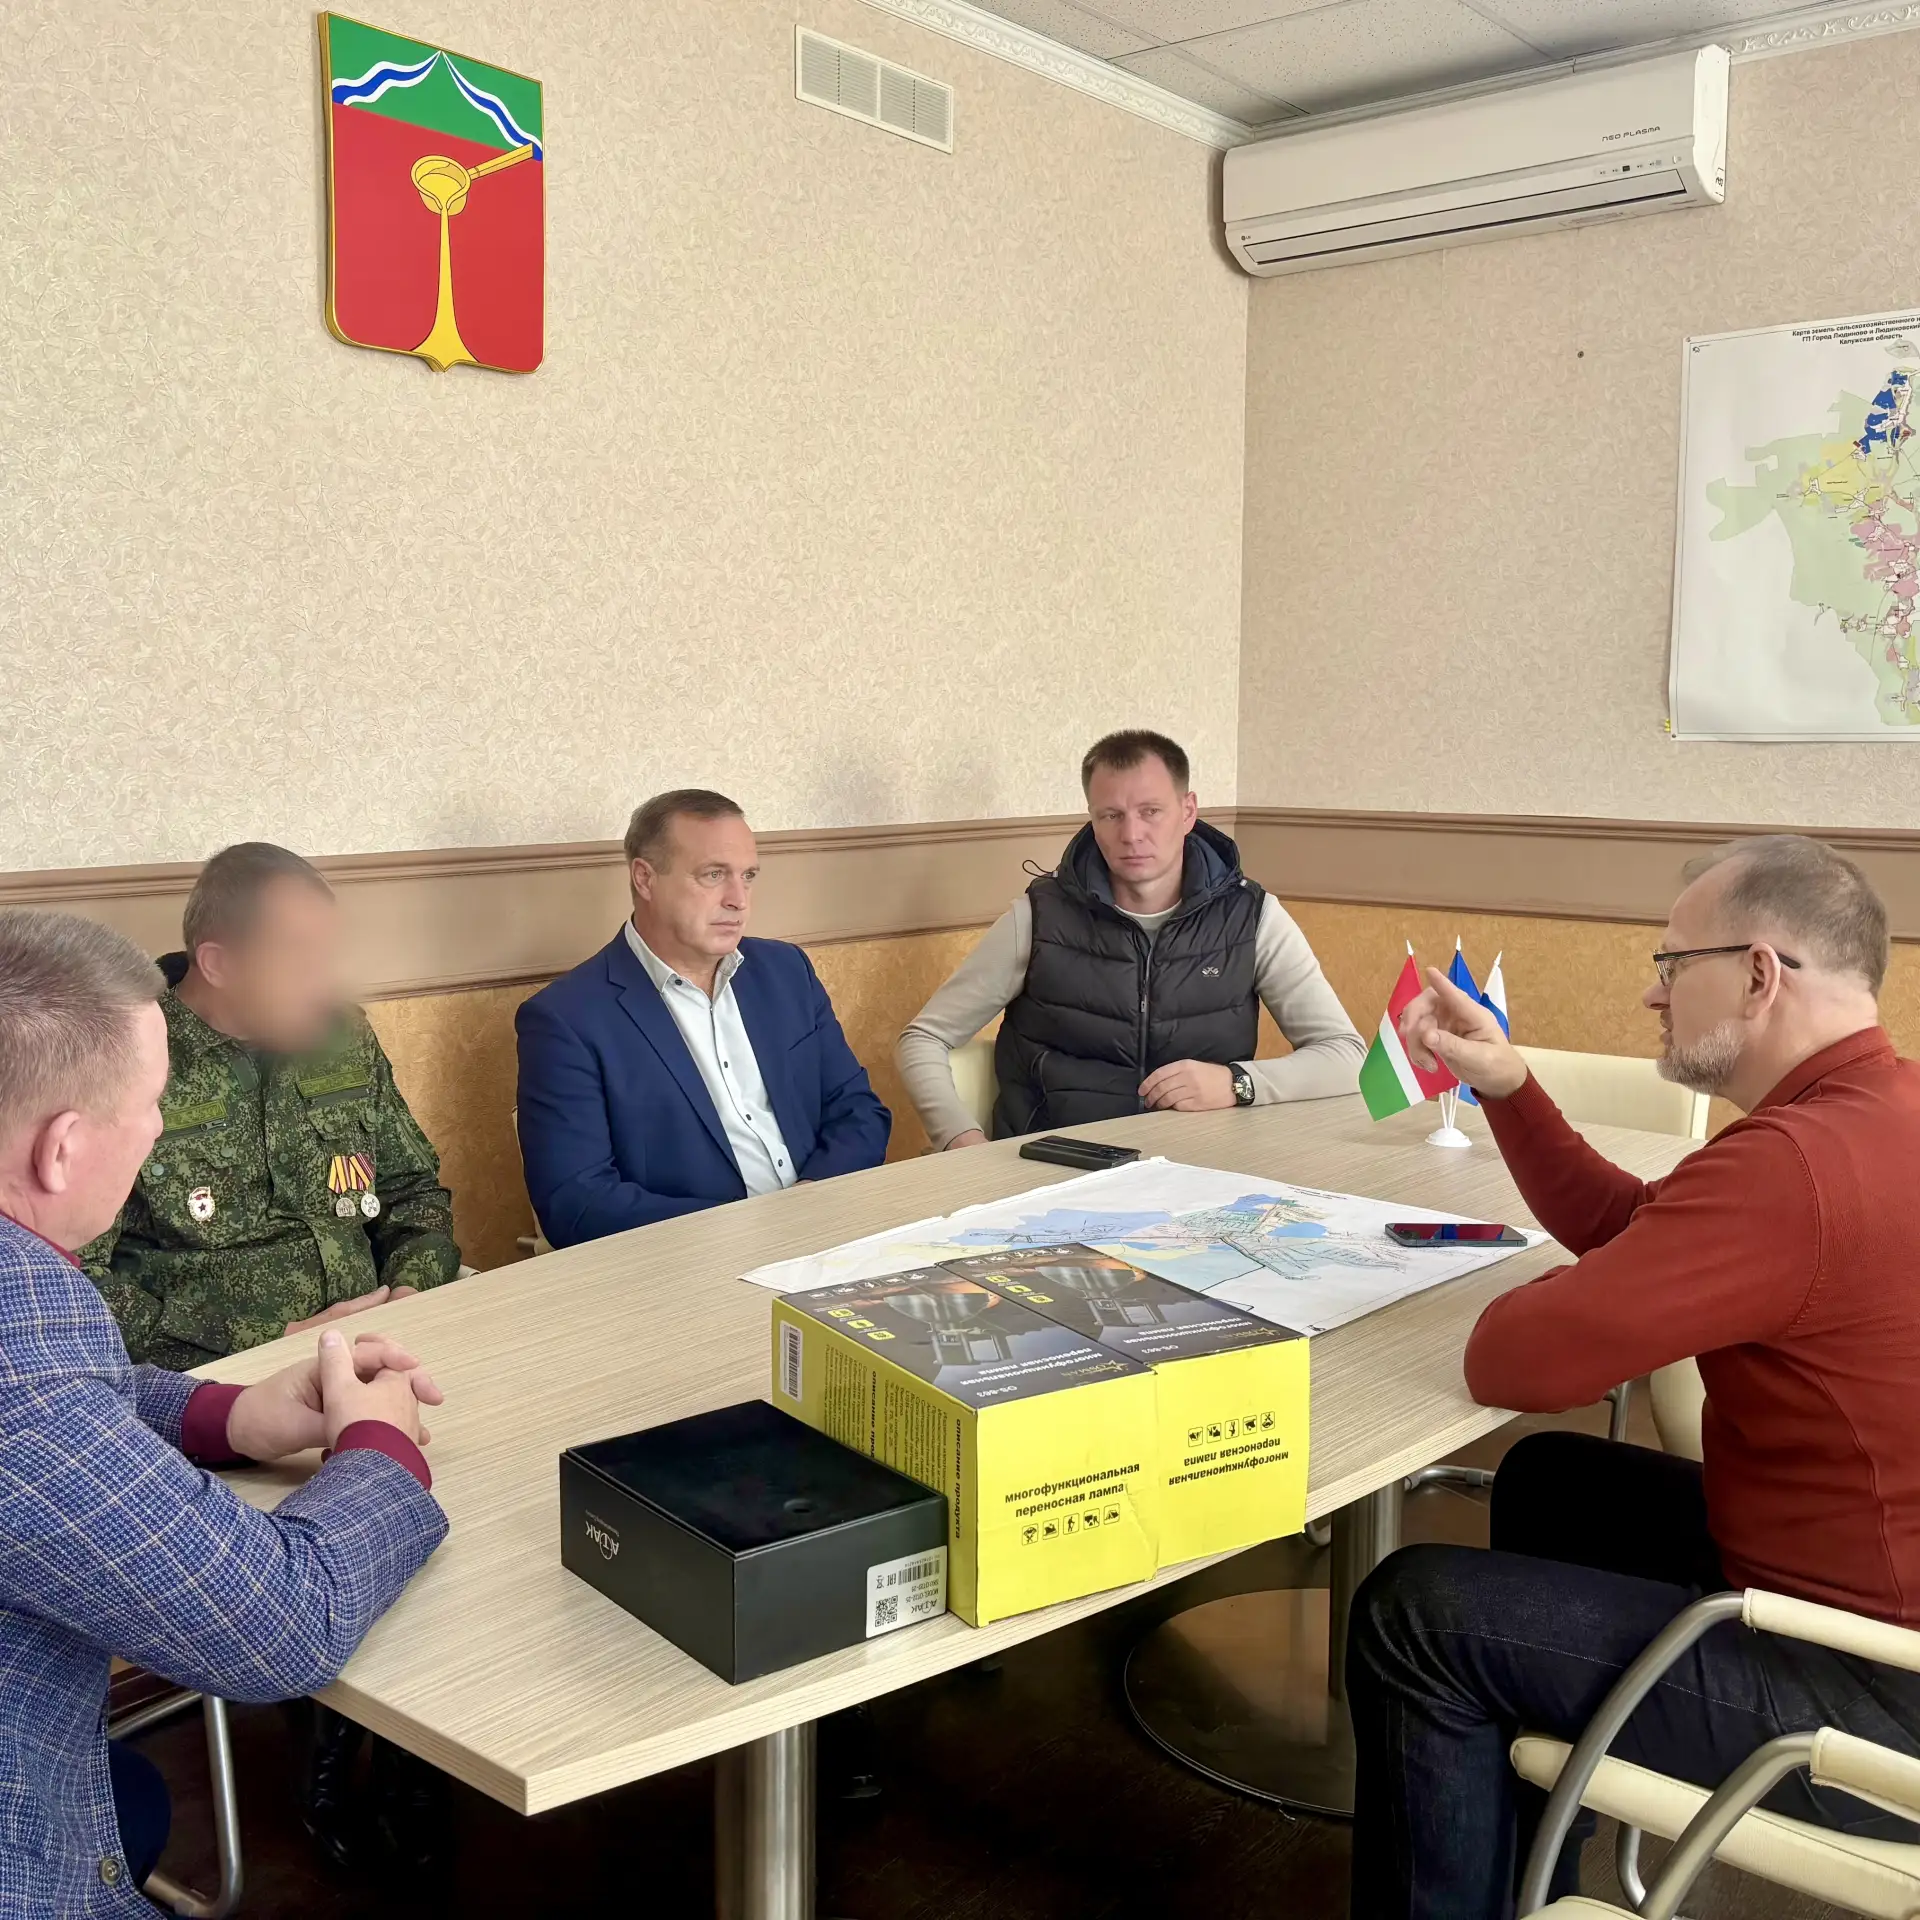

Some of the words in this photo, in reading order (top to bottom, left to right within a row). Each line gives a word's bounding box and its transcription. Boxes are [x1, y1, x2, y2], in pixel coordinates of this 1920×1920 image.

[1623, 126, 1661, 138] PLASMA
[1792, 329, 1811, 337] Карта
[1811, 327, 1835, 335] земель
[1836, 317, 1916, 331] сельскохозяйственного
[1802, 335, 1811, 343] ГП
[1812, 334, 1832, 342] Город
[1833, 330, 1868, 340] Людиново
[1839, 336, 1874, 345] Калужская
[1875, 333, 1903, 341] область
[1020, 1347, 1093, 1368] переносная
[960, 1352, 1103, 1386] многофункциональная
[977, 1364, 1019, 1376] лампа
[1219, 1437, 1281, 1459] переносная
[1168, 1451, 1289, 1486] многофункциональная
[1183, 1451, 1217, 1467] лампа
[1004, 1463, 1140, 1504] многофункциональная
[1015, 1492, 1086, 1518] переносная
[1088, 1483, 1124, 1500] лампа
